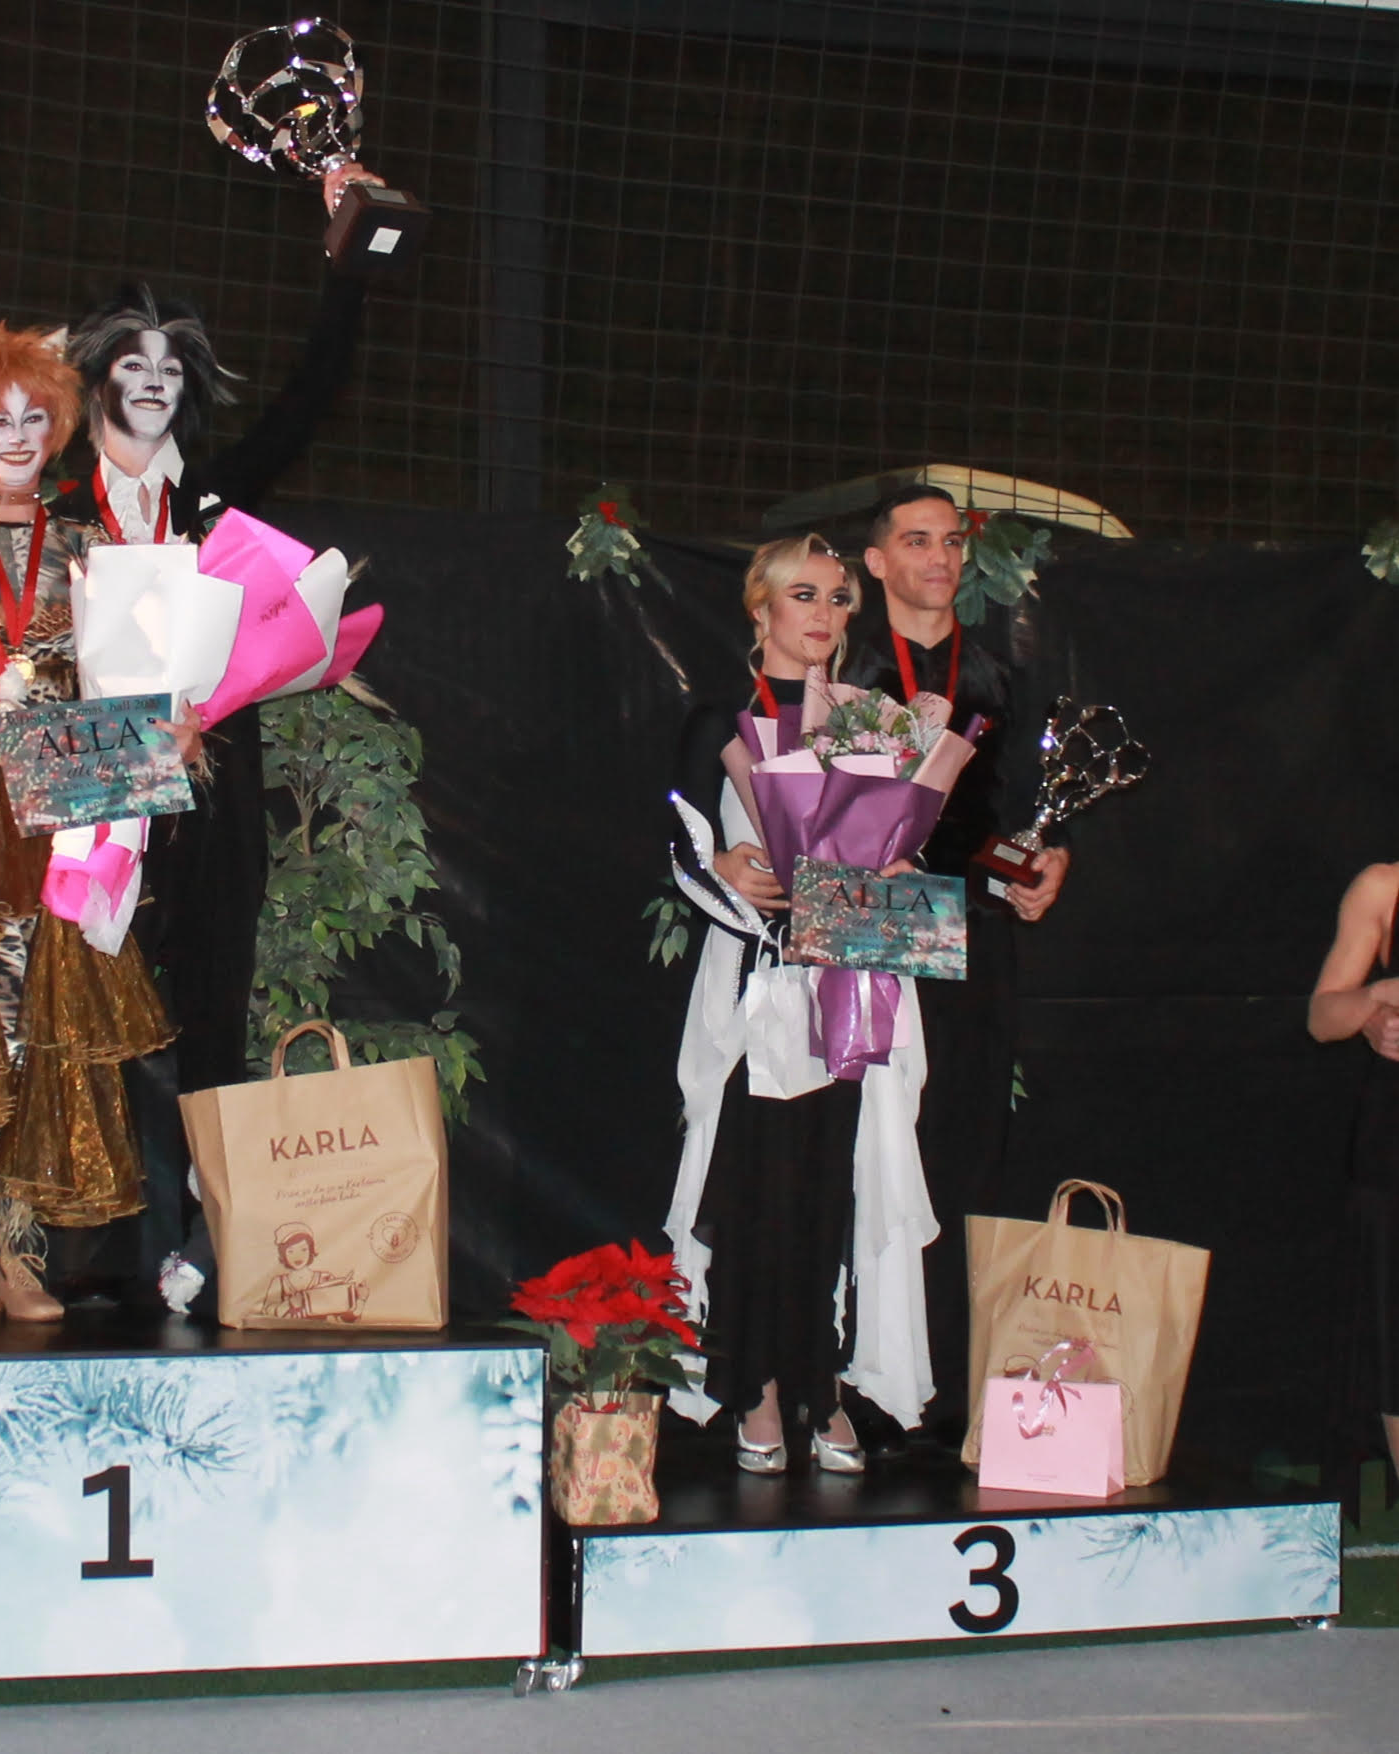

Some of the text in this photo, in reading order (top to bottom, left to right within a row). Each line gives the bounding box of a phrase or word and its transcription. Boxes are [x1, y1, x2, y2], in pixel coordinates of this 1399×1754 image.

[38, 716, 145, 760] ALLA
[828, 881, 937, 915] ALLA
[270, 1124, 380, 1162] KARLA
[1023, 1275, 1122, 1315] KARLA
[81, 1464, 154, 1579] 1
[948, 1524, 1019, 1634] 3
